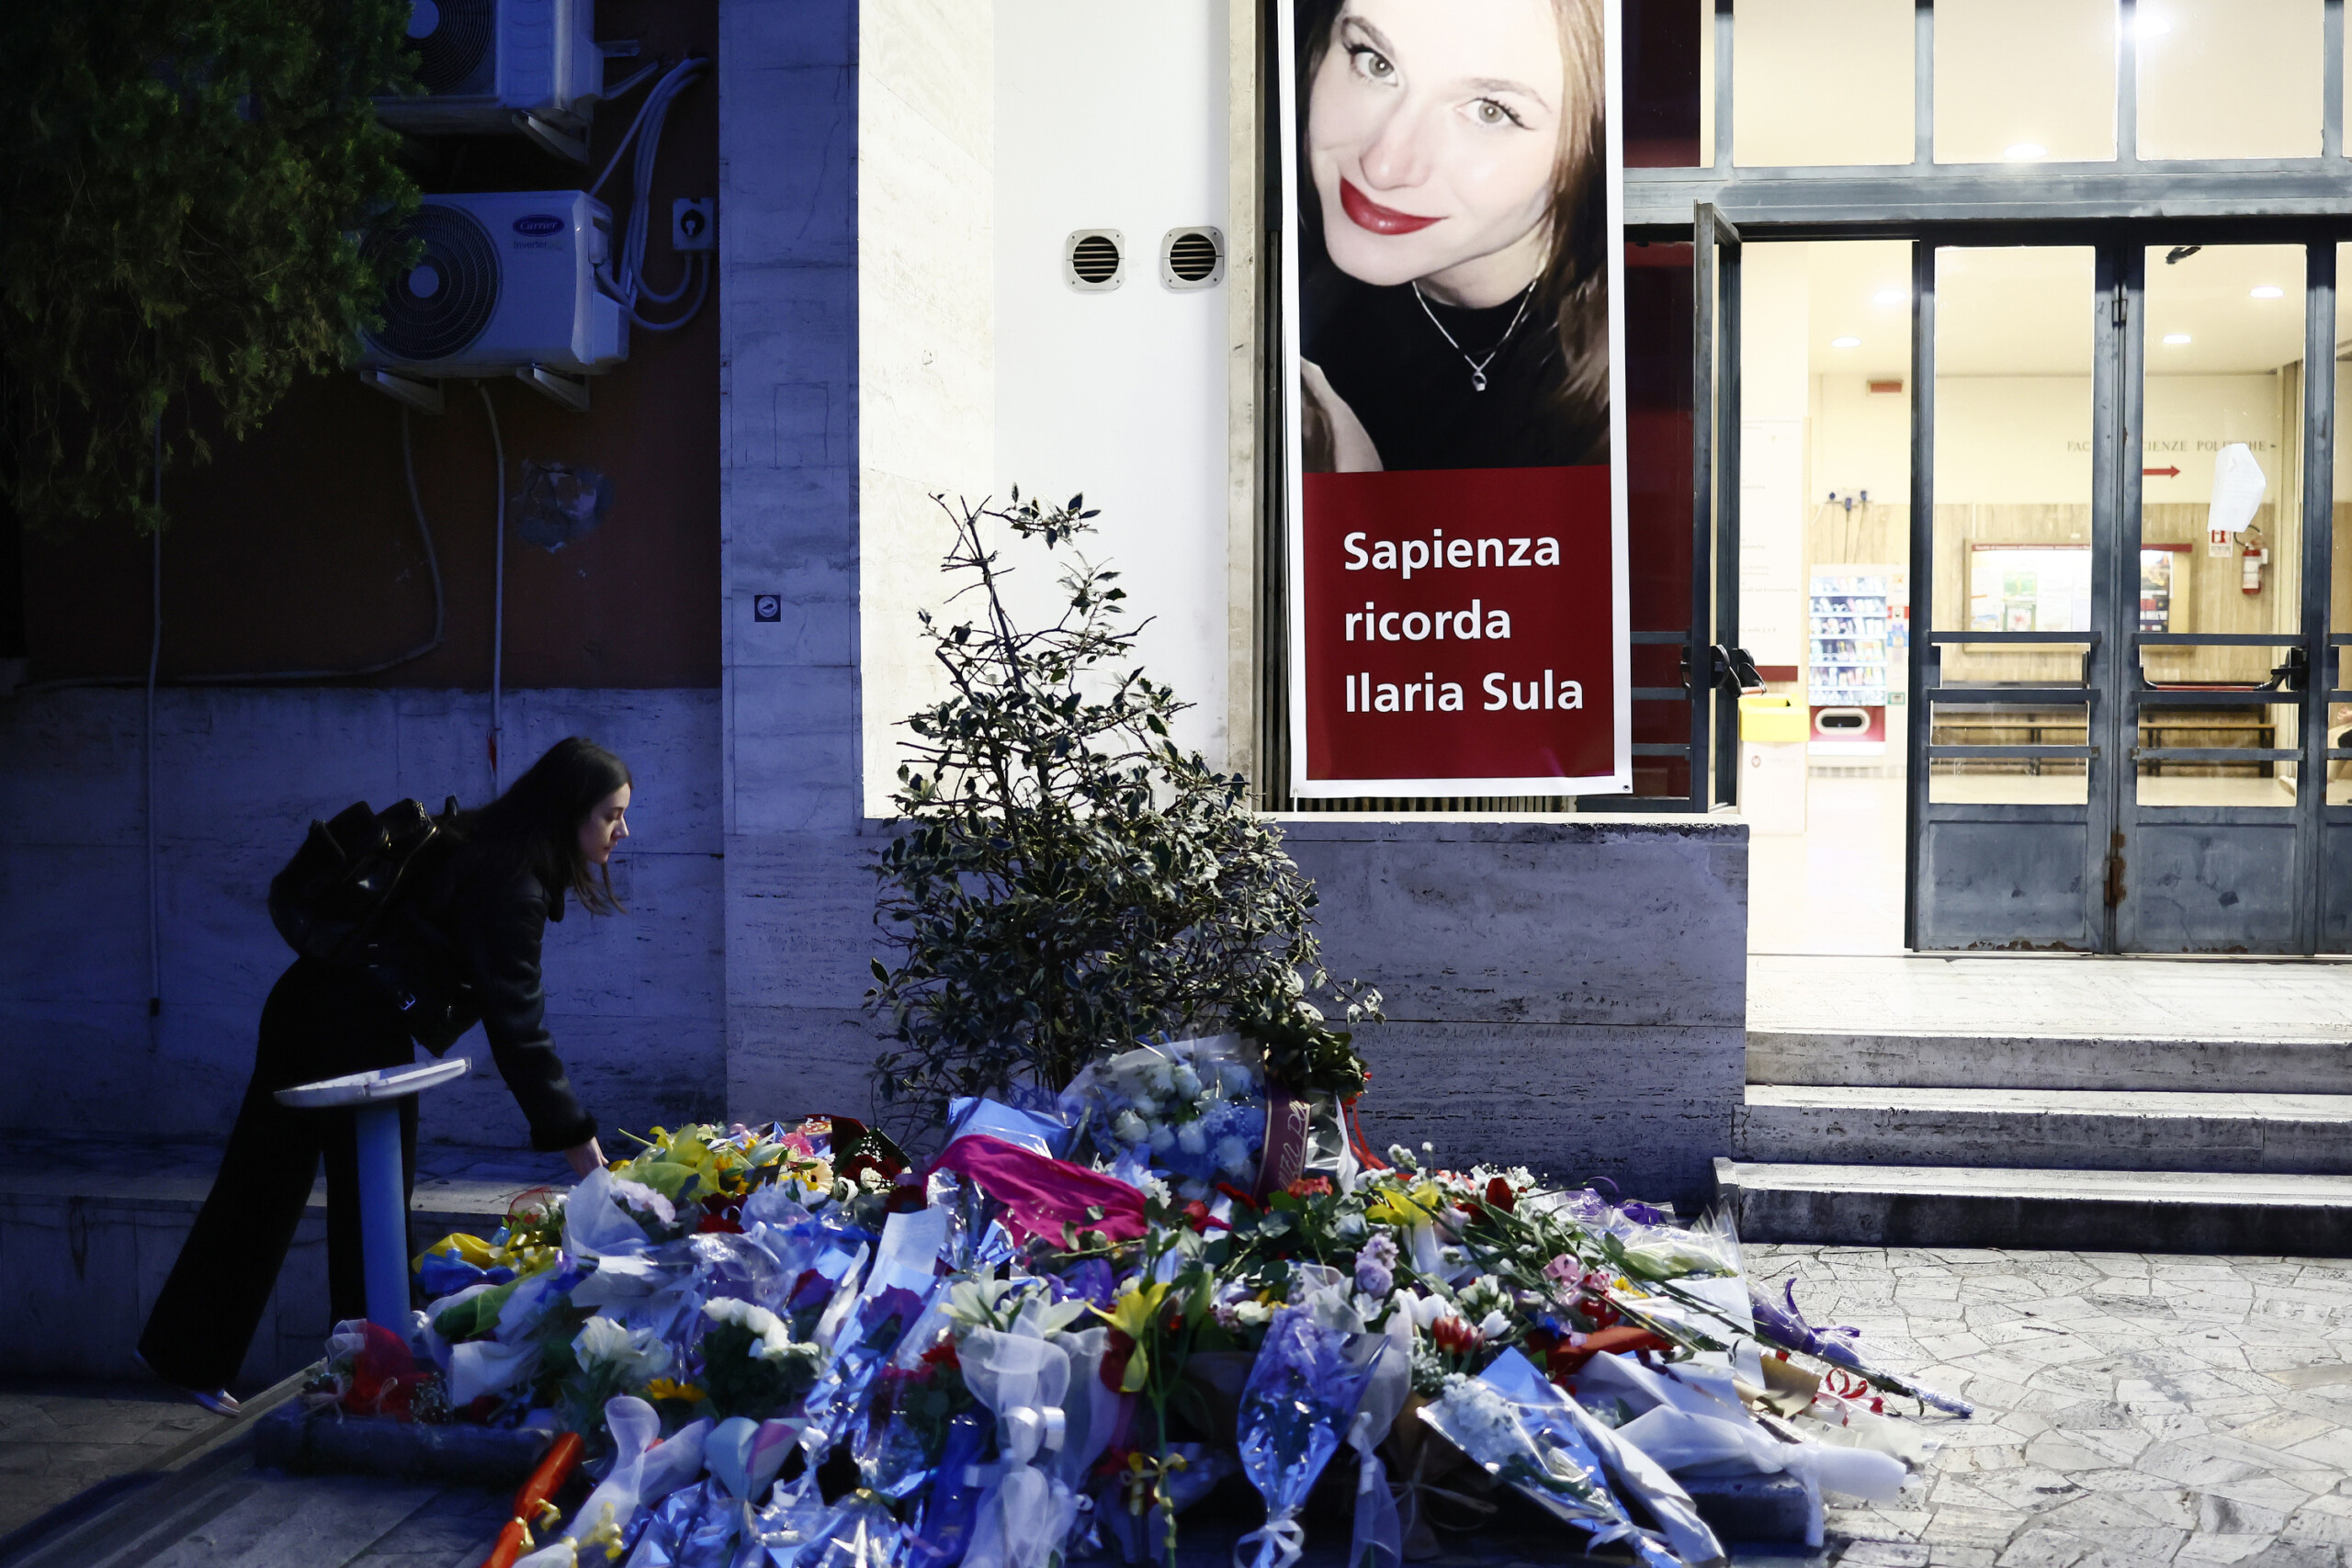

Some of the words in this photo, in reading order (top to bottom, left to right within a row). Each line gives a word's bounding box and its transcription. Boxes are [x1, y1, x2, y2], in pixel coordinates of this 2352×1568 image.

[513, 240, 548, 251] Inverter
[520, 220, 559, 231] Carrier
[1343, 528, 1560, 580] Sapienza
[1345, 598, 1511, 641] ricorda
[1346, 671, 1464, 713] Ilaria
[1482, 669, 1583, 712] Sula
